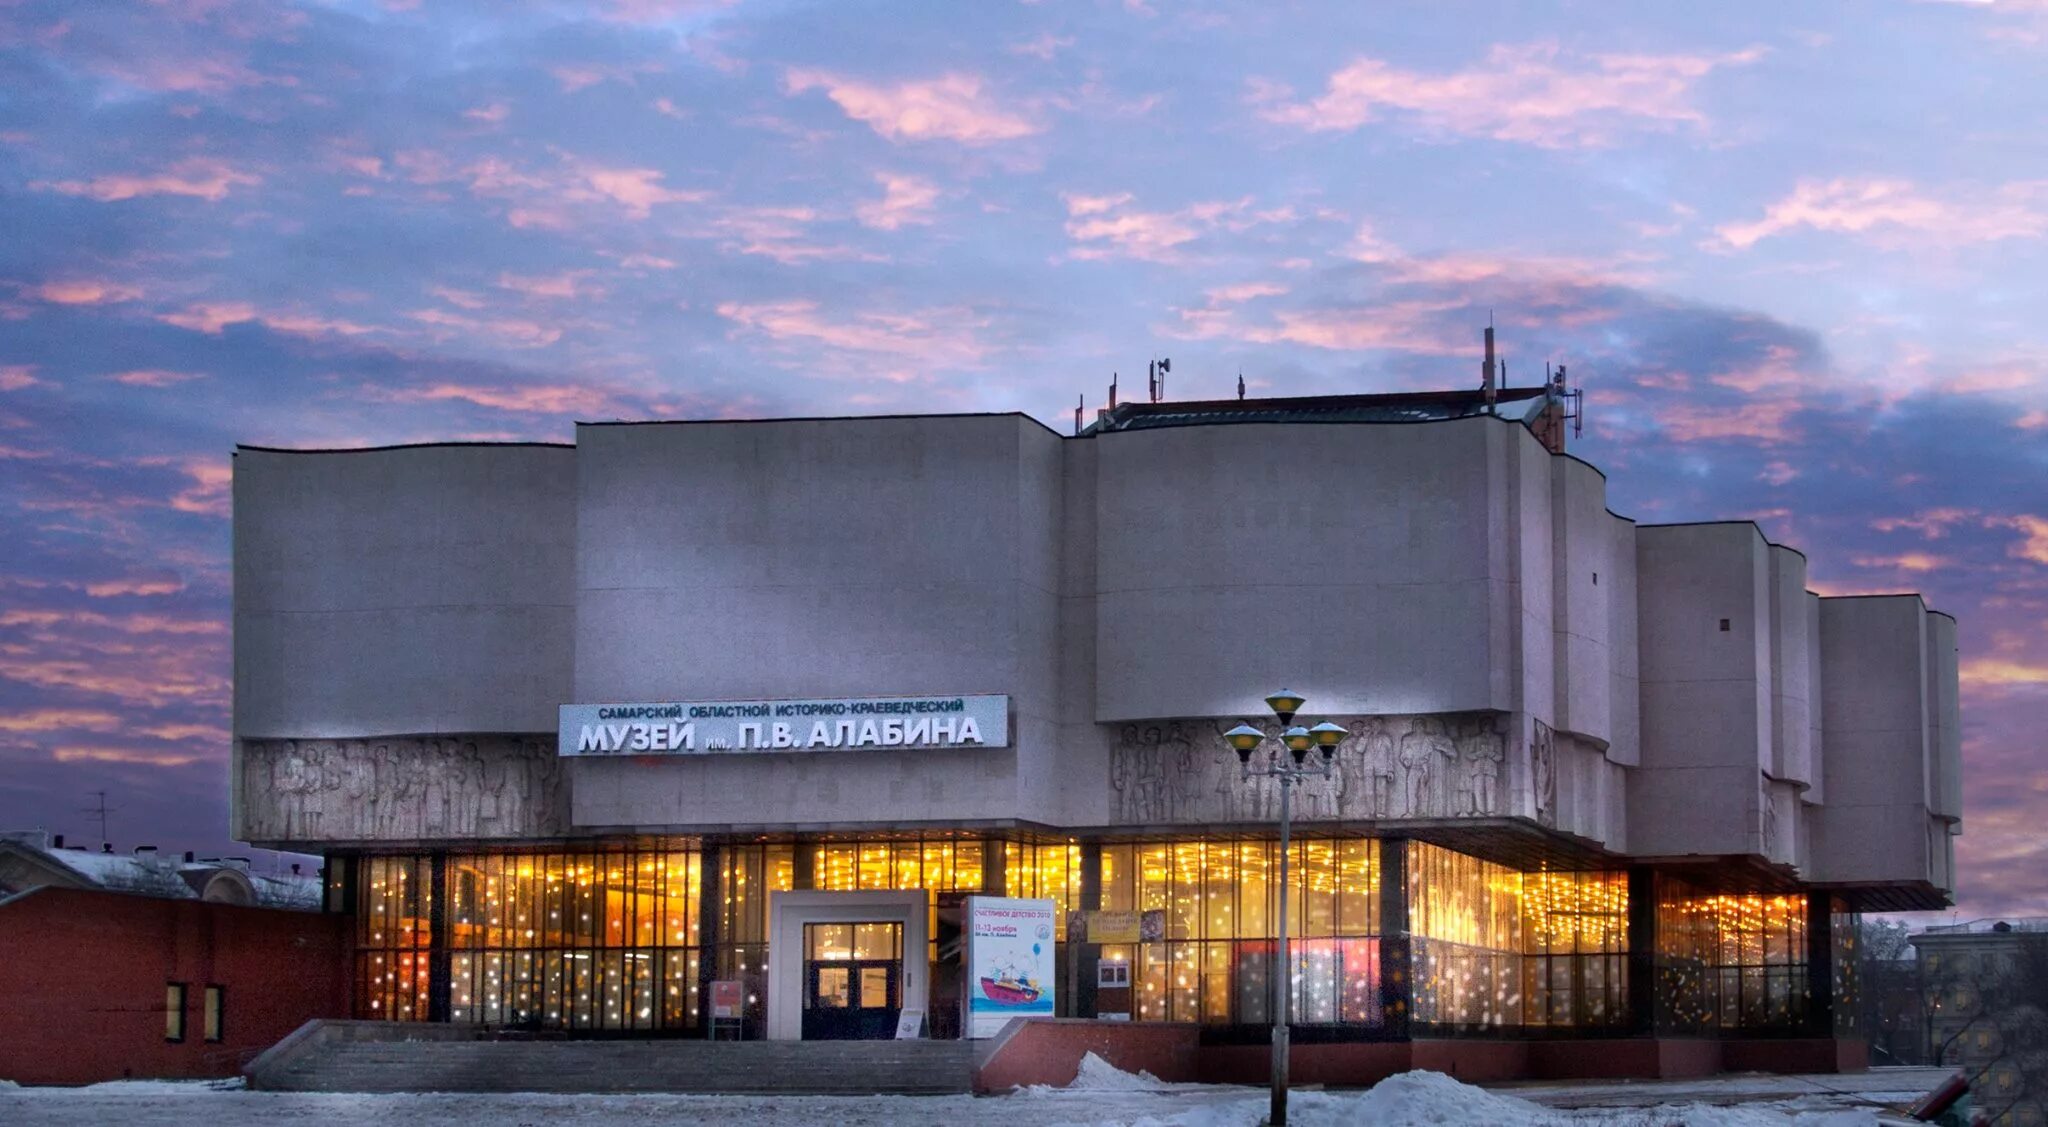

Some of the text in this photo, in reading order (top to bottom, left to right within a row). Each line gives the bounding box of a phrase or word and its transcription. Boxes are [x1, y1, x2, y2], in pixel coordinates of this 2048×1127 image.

[598, 698, 964, 719] САМАРСКИЙ ОБЛАСТНОЙ ИСТОРИКО-КРАЕВЕДЧЕСКИЙ
[577, 716, 696, 751] МУЗЕЙ
[738, 721, 801, 750] П.В.
[807, 716, 984, 748] АЛАБИНА
